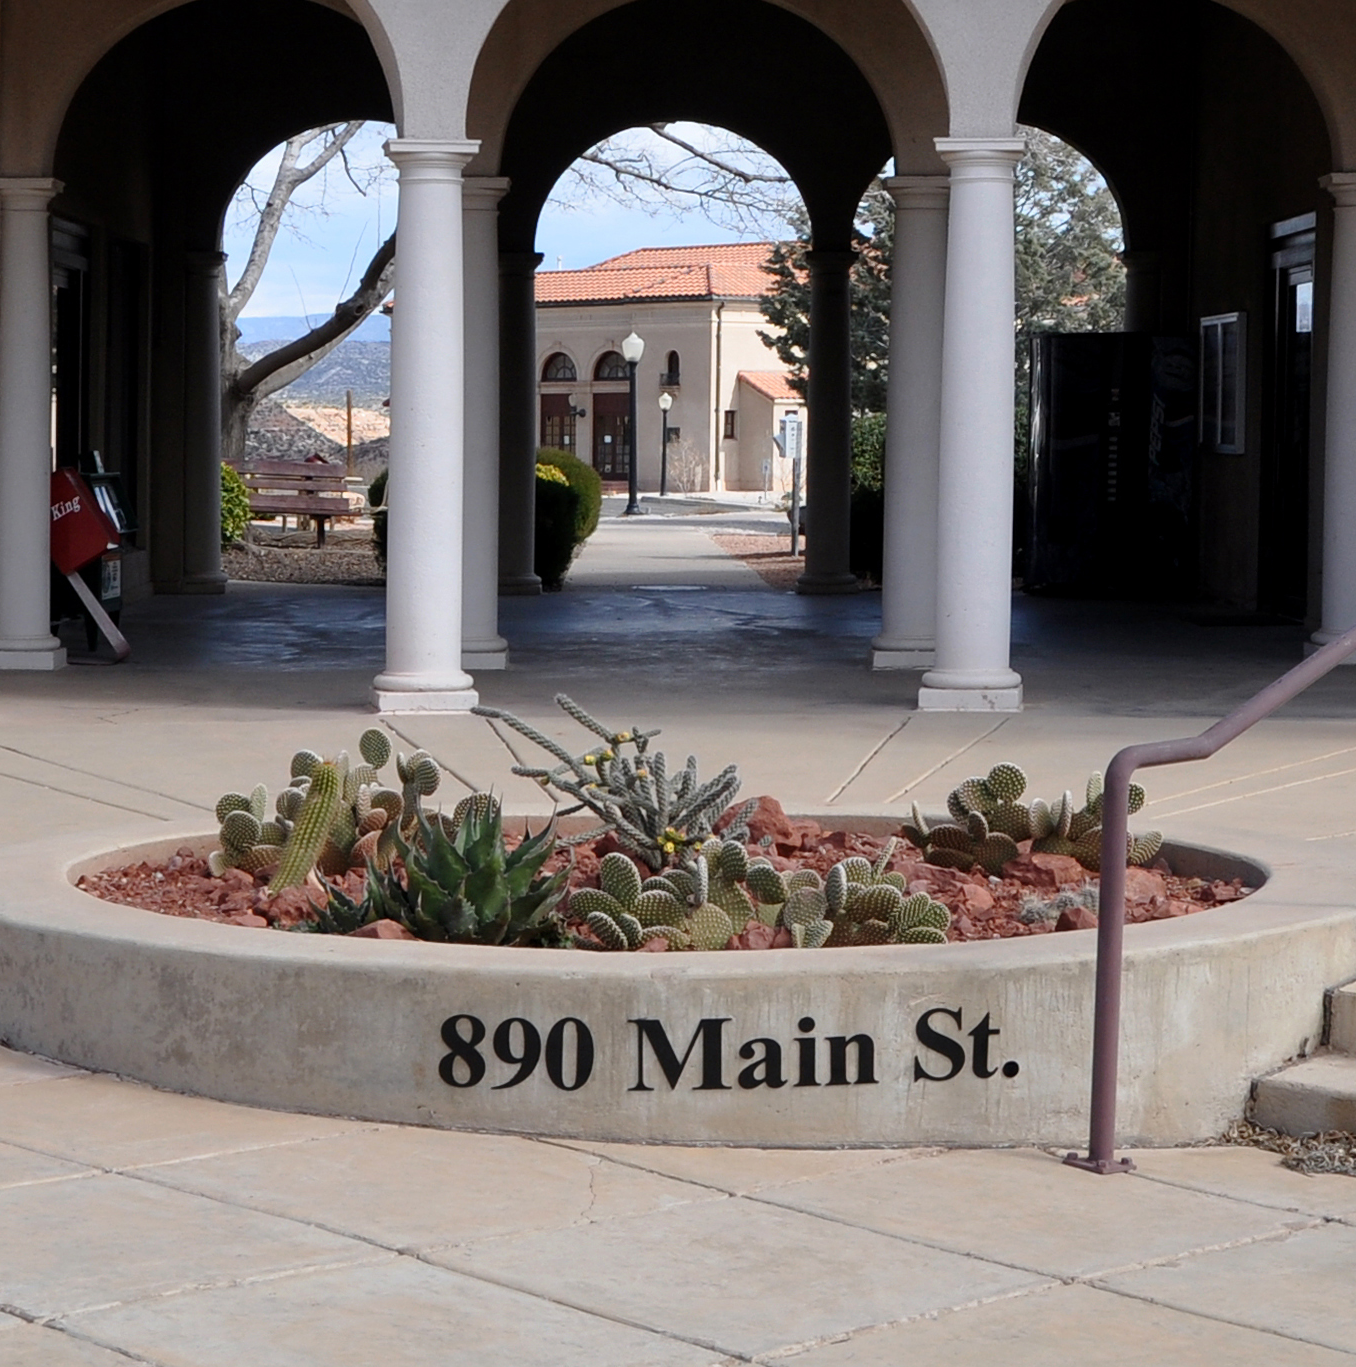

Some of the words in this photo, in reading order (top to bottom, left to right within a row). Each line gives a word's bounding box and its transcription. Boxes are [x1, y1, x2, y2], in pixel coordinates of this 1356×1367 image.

[1148, 393, 1165, 467] PEPSI
[50, 496, 81, 521] King
[438, 1013, 595, 1092] 890
[627, 1016, 879, 1092] Main
[913, 1006, 1021, 1084] St.
